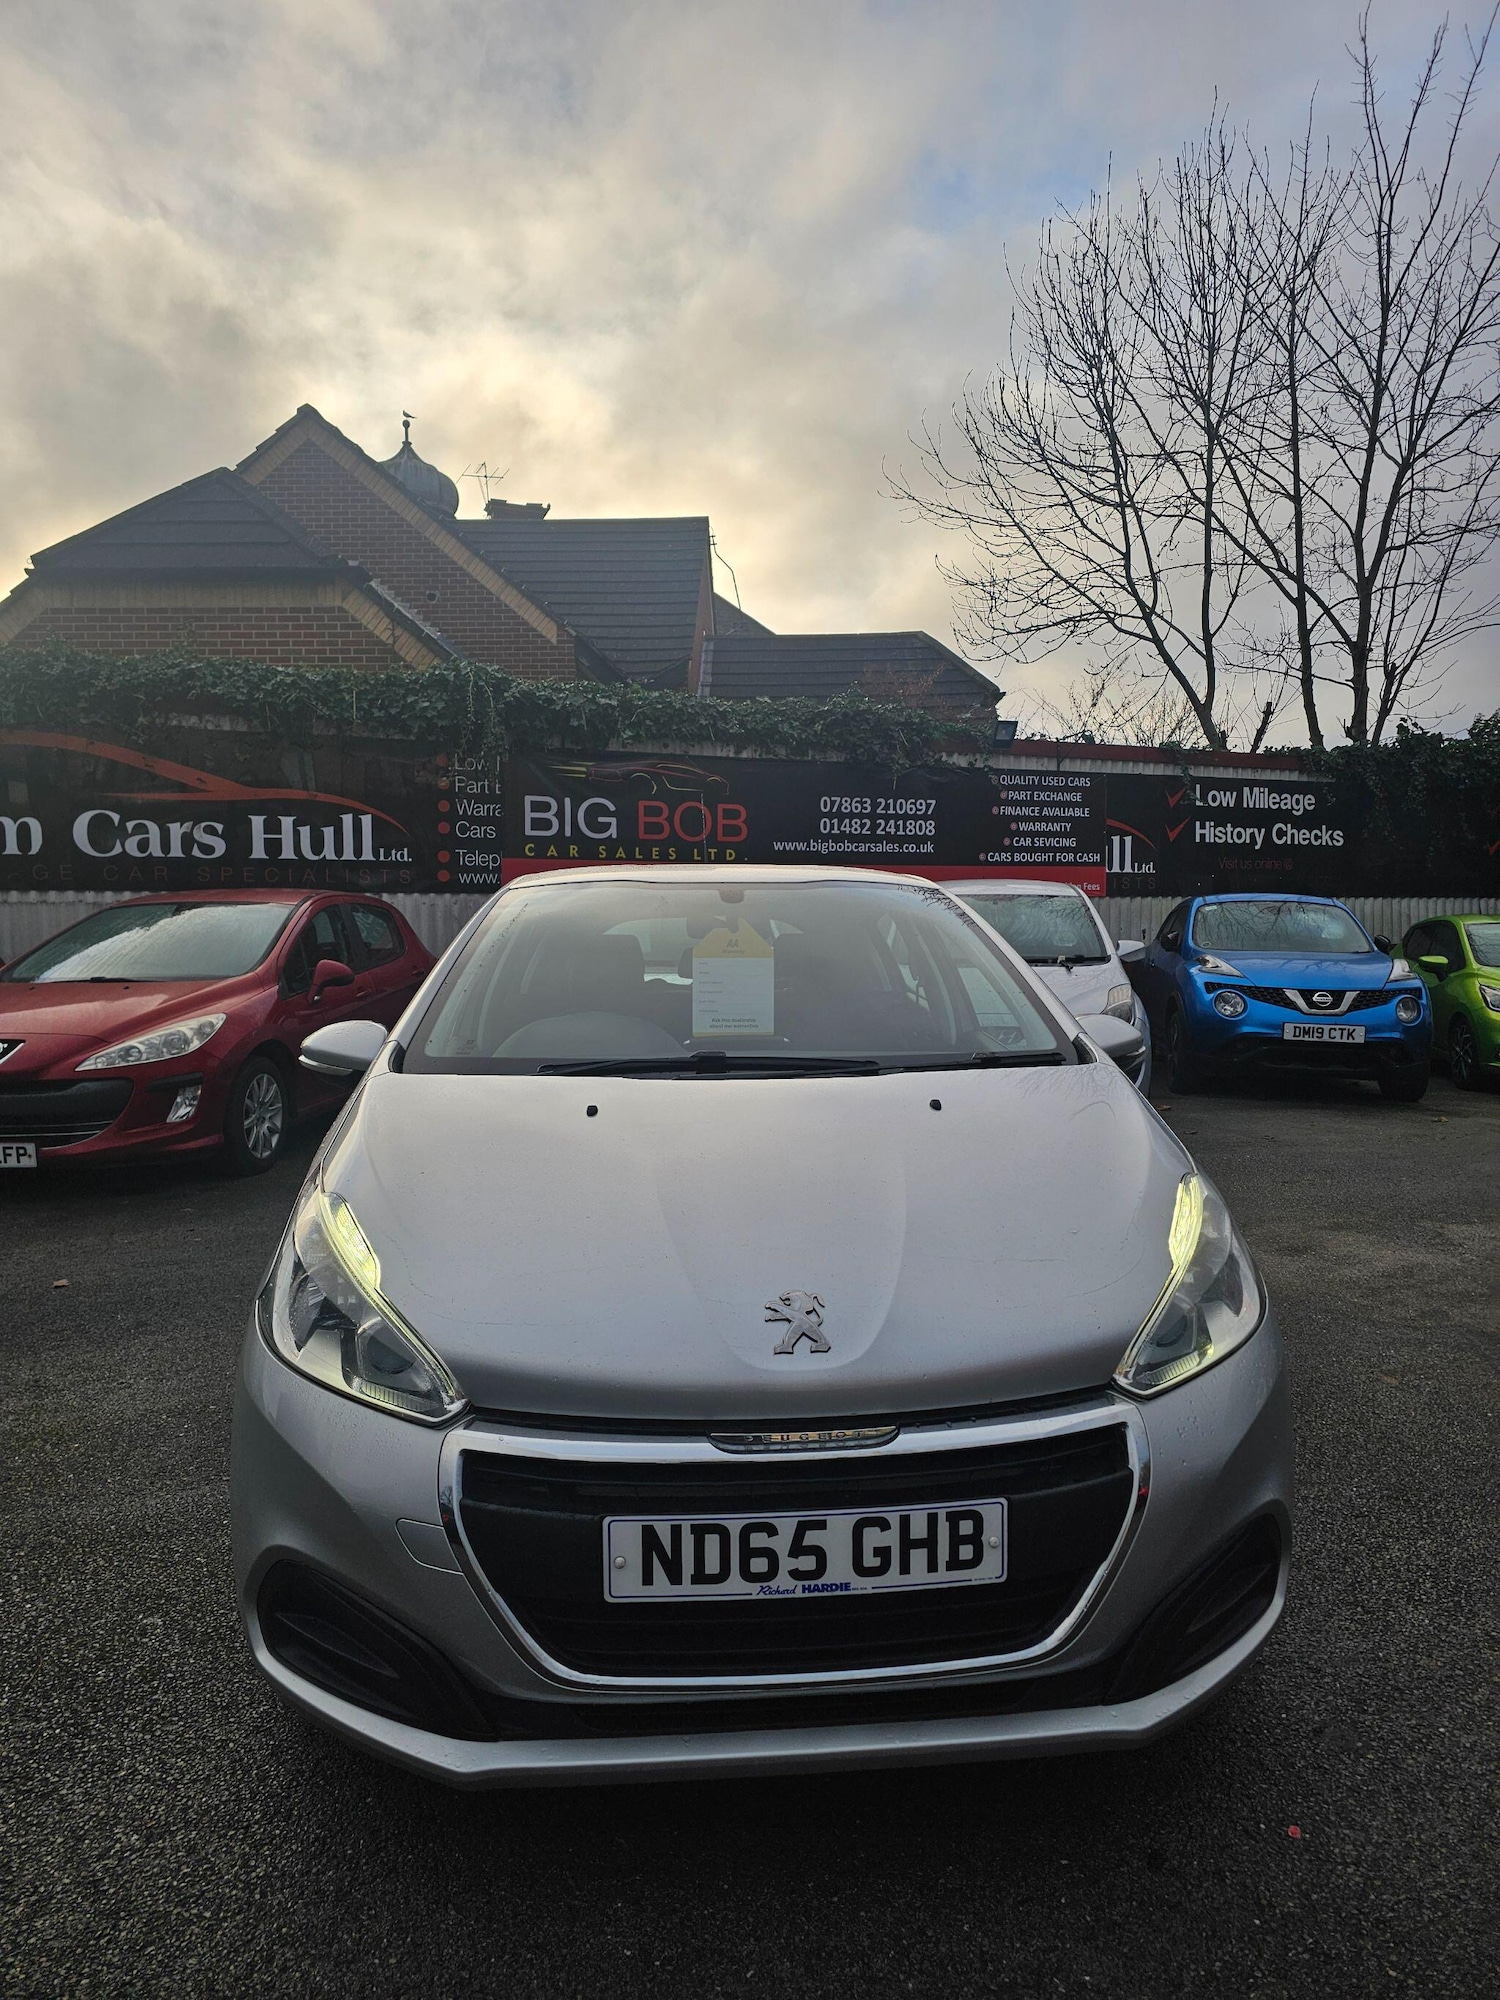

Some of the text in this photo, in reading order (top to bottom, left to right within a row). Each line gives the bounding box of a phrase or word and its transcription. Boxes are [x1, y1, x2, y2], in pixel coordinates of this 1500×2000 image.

[455, 776, 489, 794] Part
[1000, 775, 1091, 787] QUALITY USED CARS
[1008, 791, 1082, 801] PART EXCHANGE
[1195, 784, 1316, 816] Low Mileage
[820, 797, 936, 815] 07863 210697
[1000, 806, 1090, 817] FINANCE AVALIABLE
[524, 795, 748, 842] BIG BOB
[456, 821, 496, 838] Cars
[820, 818, 936, 836] 01482 241808
[1018, 822, 1071, 832] WARRANTY
[73, 809, 227, 859] Cars
[248, 813, 376, 861] Hull
[379, 848, 413, 862] Ltd.
[1013, 837, 1077, 847] CAR SEVICING
[1195, 821, 1344, 850] History Checks
[525, 843, 749, 862] CAR SALES LTD.
[773, 839, 935, 855] www.bigbobcarsales.co.uk
[455, 850, 500, 870] Telep
[987, 852, 1100, 862] CARS BOUGHT FOR CASH
[1219, 857, 1238, 869] Visit
[1240, 859, 1252, 870] us
[1254, 858, 1282, 870] online
[103, 865, 168, 881] CAR
[197, 867, 411, 884] SPECIALISTS
[1134, 862, 1156, 873] Ltd.
[459, 873, 500, 884] www.
[1083, 882, 1100, 891] Fees
[1293, 1025, 1356, 1041] DM19 CTK
[0, 1146, 28, 1164] FP
[641, 1508, 985, 1586] ND65 GHB
[756, 1584, 797, 1596] Richard
[802, 1582, 852, 1594] HARDIE
